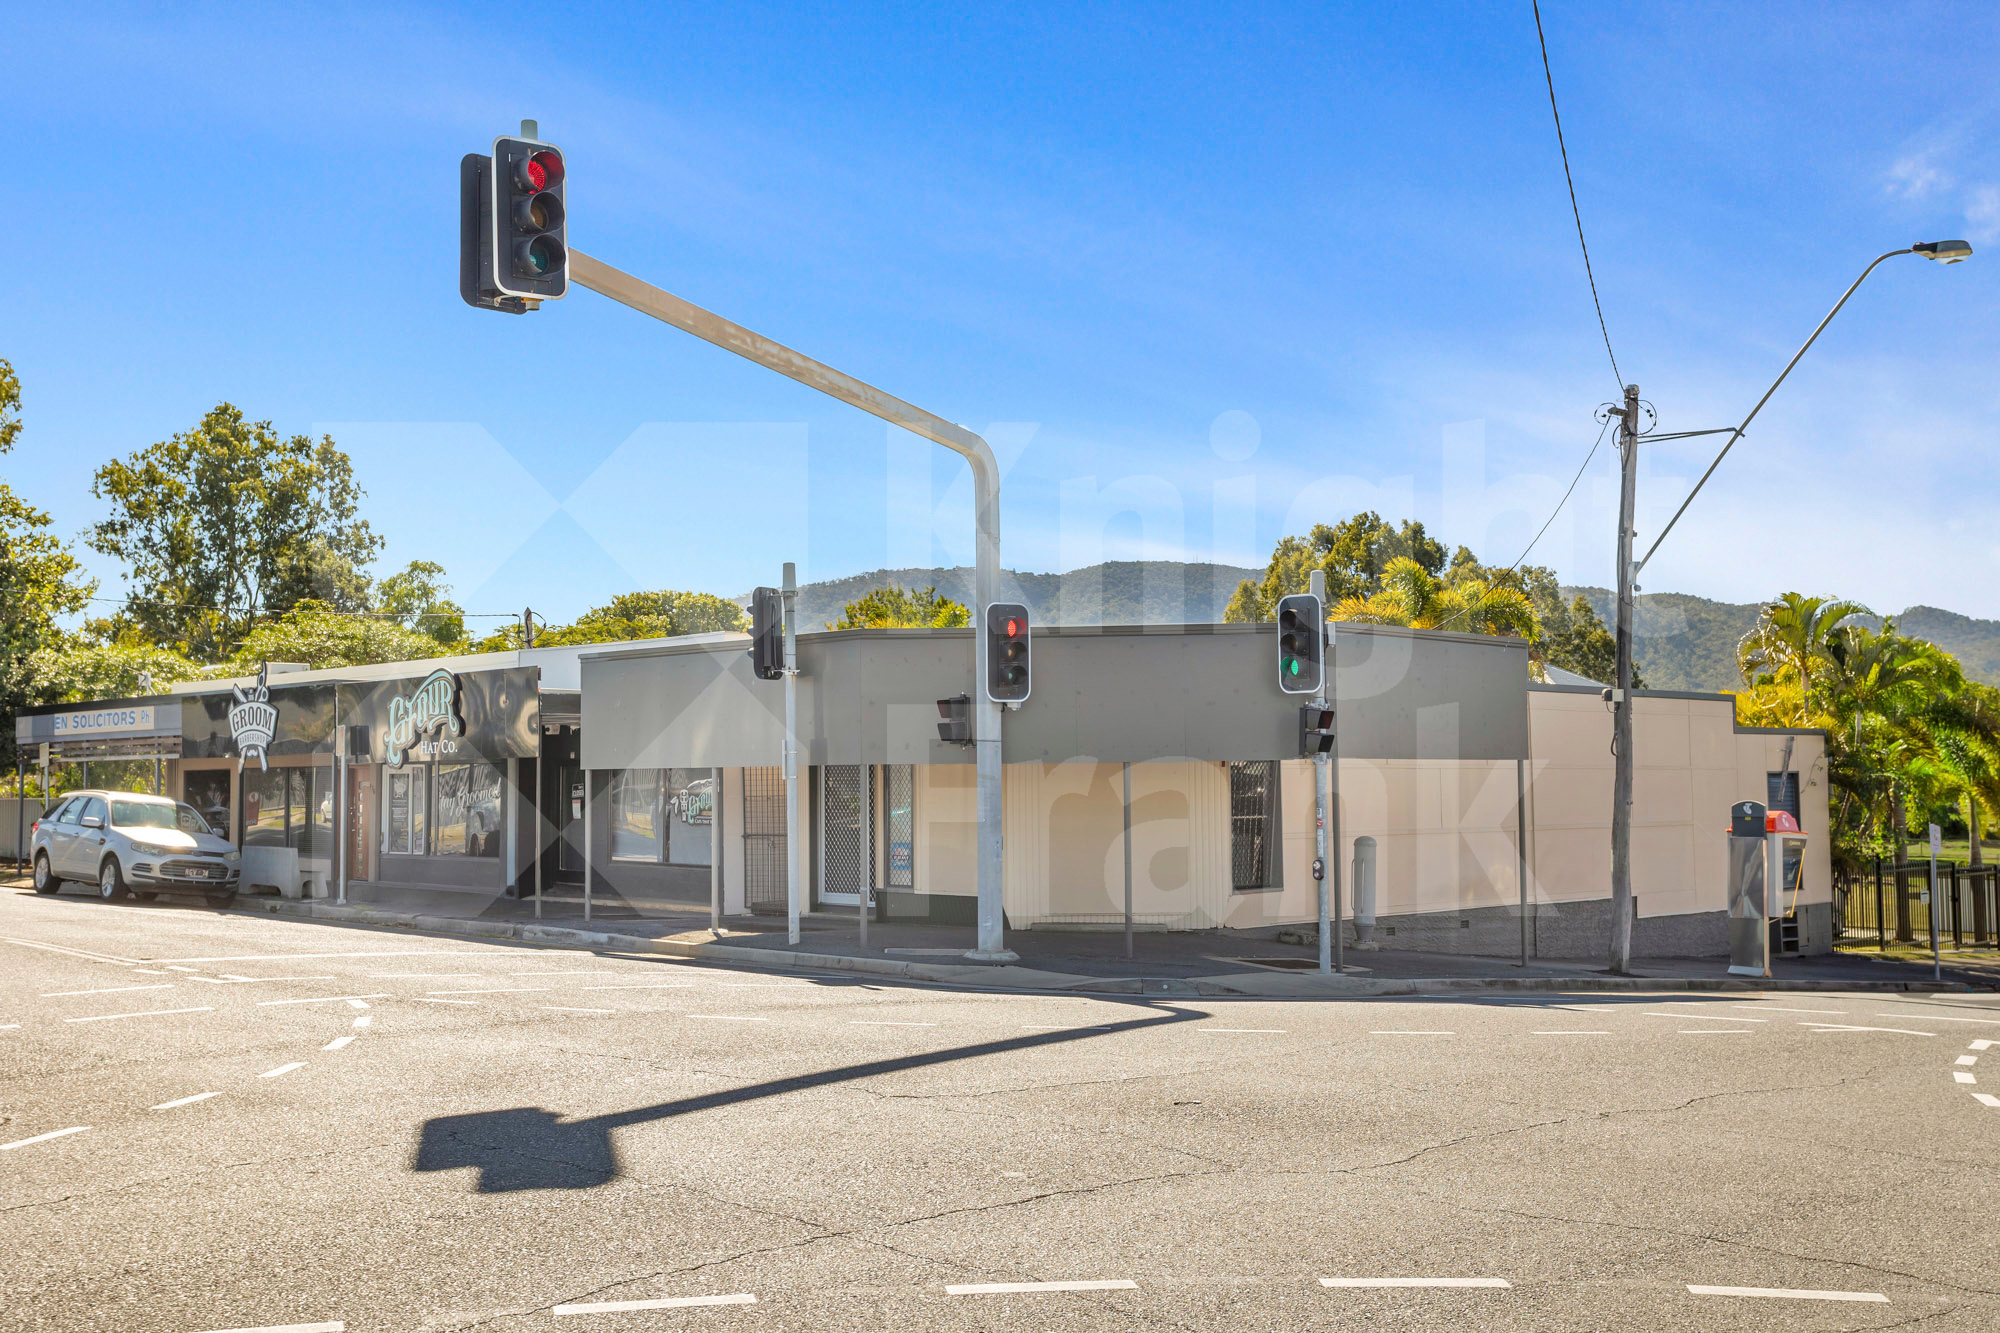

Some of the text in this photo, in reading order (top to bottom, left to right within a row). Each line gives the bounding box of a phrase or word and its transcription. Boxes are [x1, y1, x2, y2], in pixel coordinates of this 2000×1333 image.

[54, 716, 68, 730] EN
[72, 710, 136, 729] SOLICITORS
[232, 706, 273, 732] GROOM
[439, 791, 456, 816] tay
[456, 777, 501, 817] Groomed
